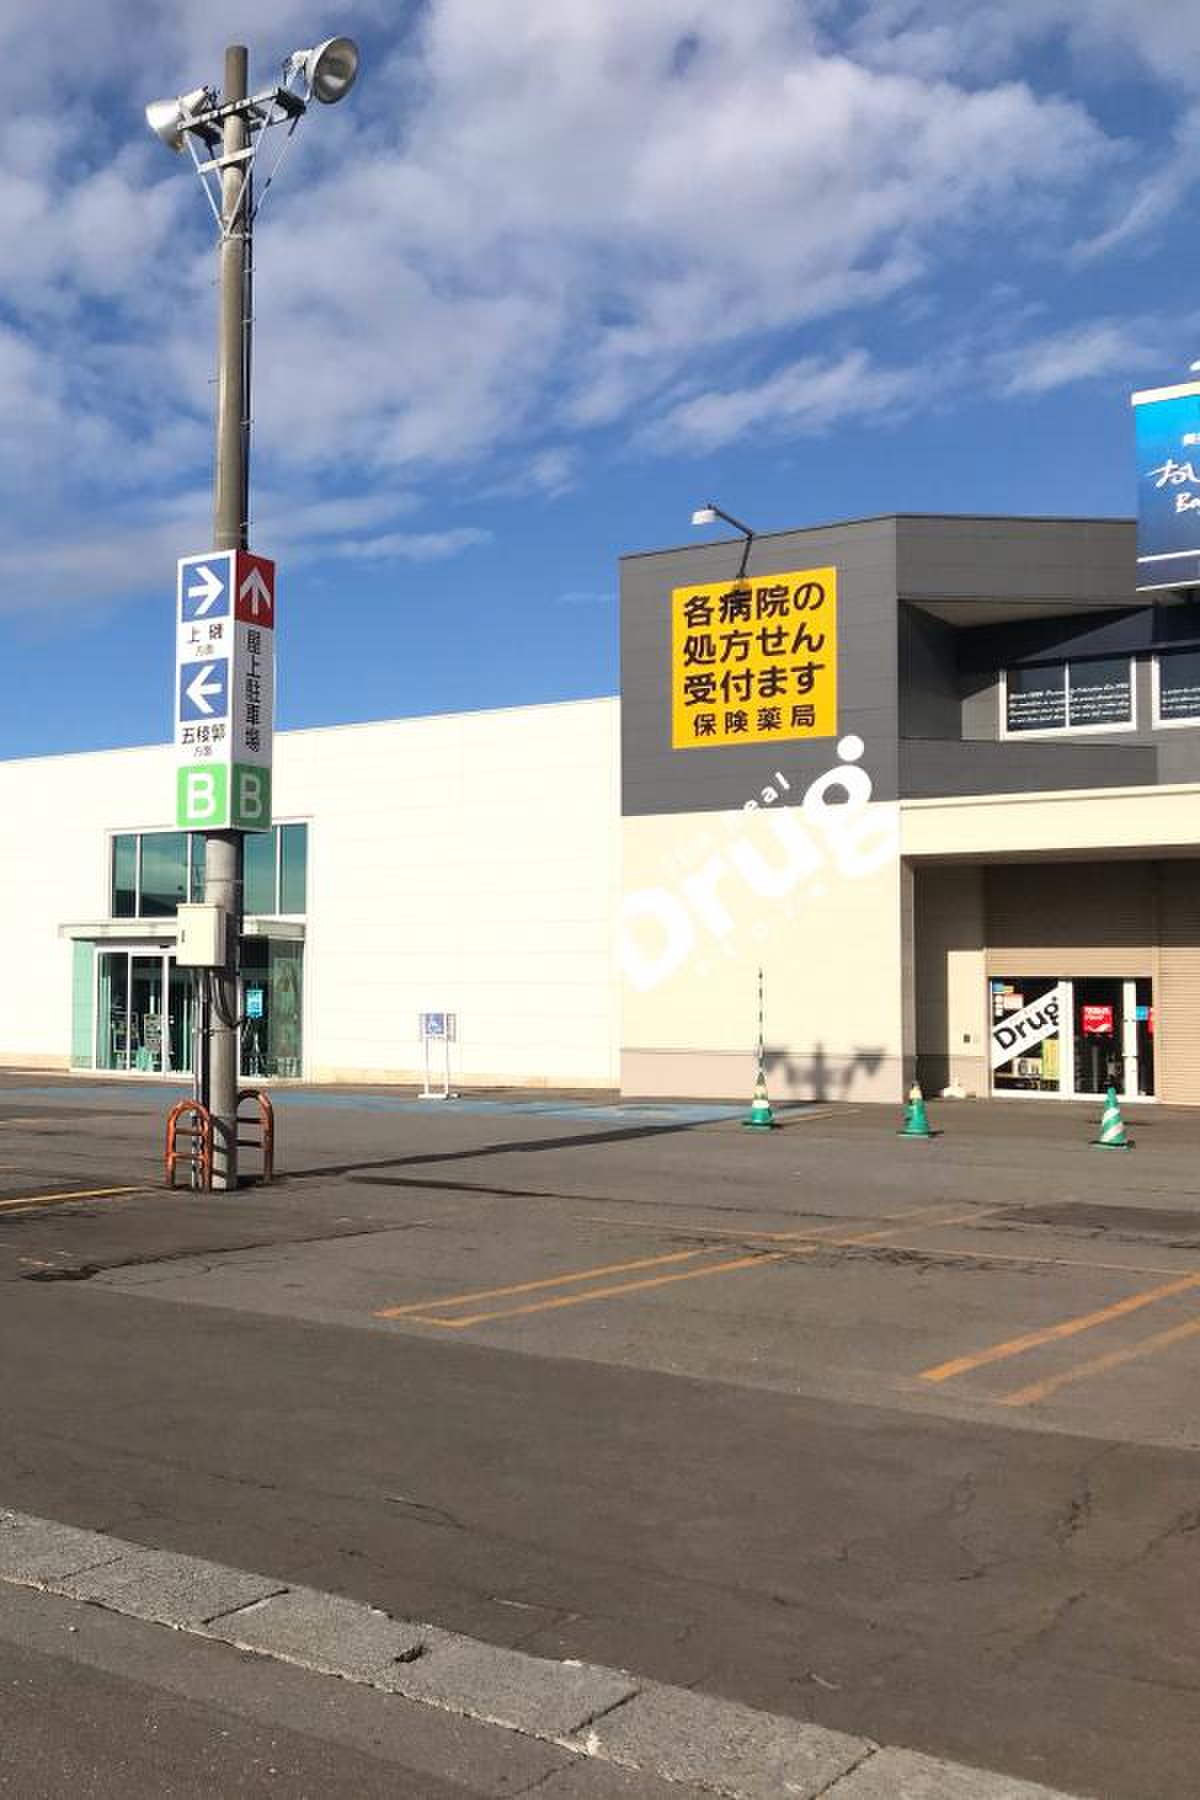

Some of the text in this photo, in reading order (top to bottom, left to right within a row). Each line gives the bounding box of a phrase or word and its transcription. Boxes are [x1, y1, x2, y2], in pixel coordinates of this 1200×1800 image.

[684, 582, 825, 628] 各病院の
[684, 622, 825, 667] 処方せん
[245, 629, 261, 752] 屋上駐車場
[684, 661, 825, 706] 受付ます
[693, 704, 816, 737] 保険薬局
[187, 773, 216, 818] B
[240, 773, 262, 817] B
[993, 996, 1059, 1051] Drug
